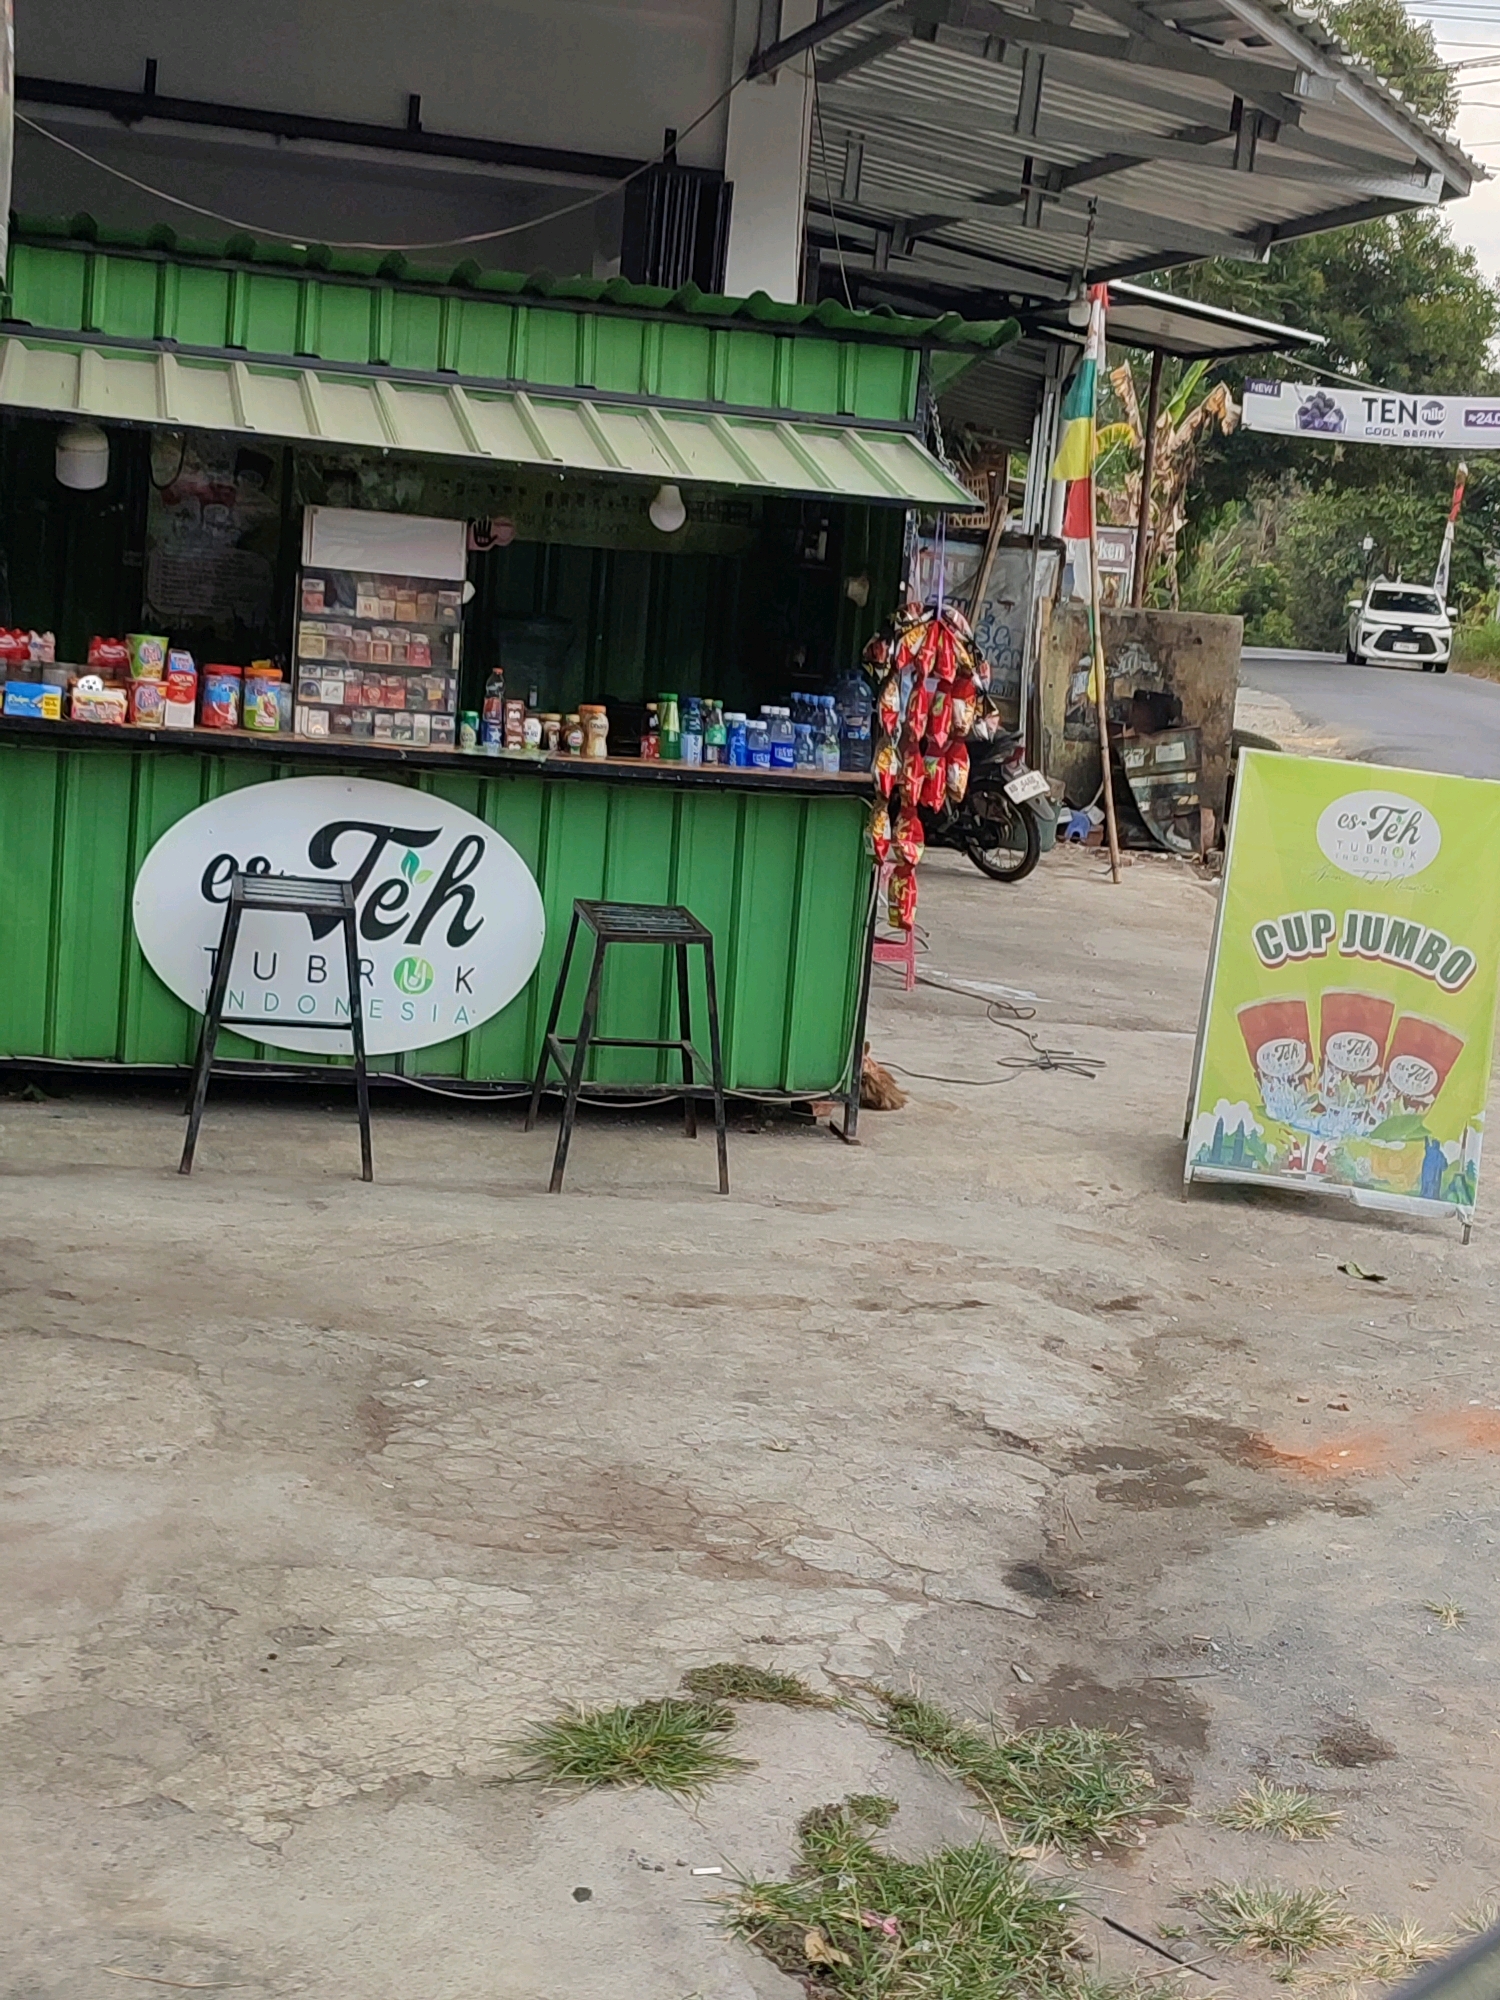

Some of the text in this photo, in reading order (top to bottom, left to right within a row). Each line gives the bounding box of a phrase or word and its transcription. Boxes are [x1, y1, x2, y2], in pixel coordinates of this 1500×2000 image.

[1362, 397, 1418, 425] TEN
[1365, 426, 1445, 439] COOL BERRY
[1337, 805, 1423, 846] es Teh
[1335, 853, 1416, 869] INDONESIA
[1336, 839, 1417, 861] TUBROK
[308, 820, 486, 948] Teh
[1254, 911, 1474, 987] CUP JUMBO
